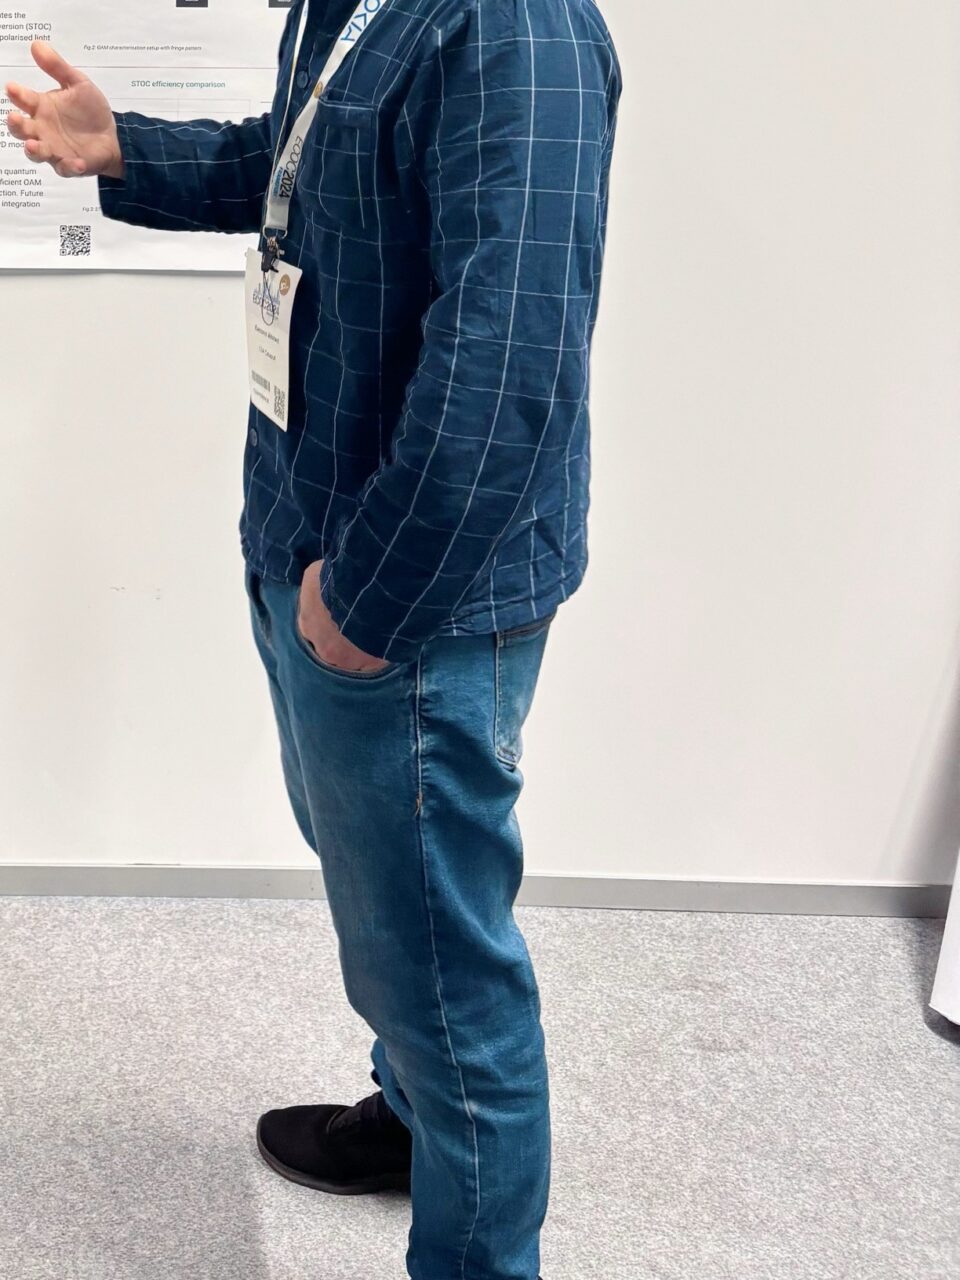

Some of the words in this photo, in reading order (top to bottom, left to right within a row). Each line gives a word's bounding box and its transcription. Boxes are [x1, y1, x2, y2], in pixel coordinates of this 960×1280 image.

[151, 80, 185, 89] efficiency
[279, 136, 304, 199] ECOC2024
[1, 201, 41, 209] integration
